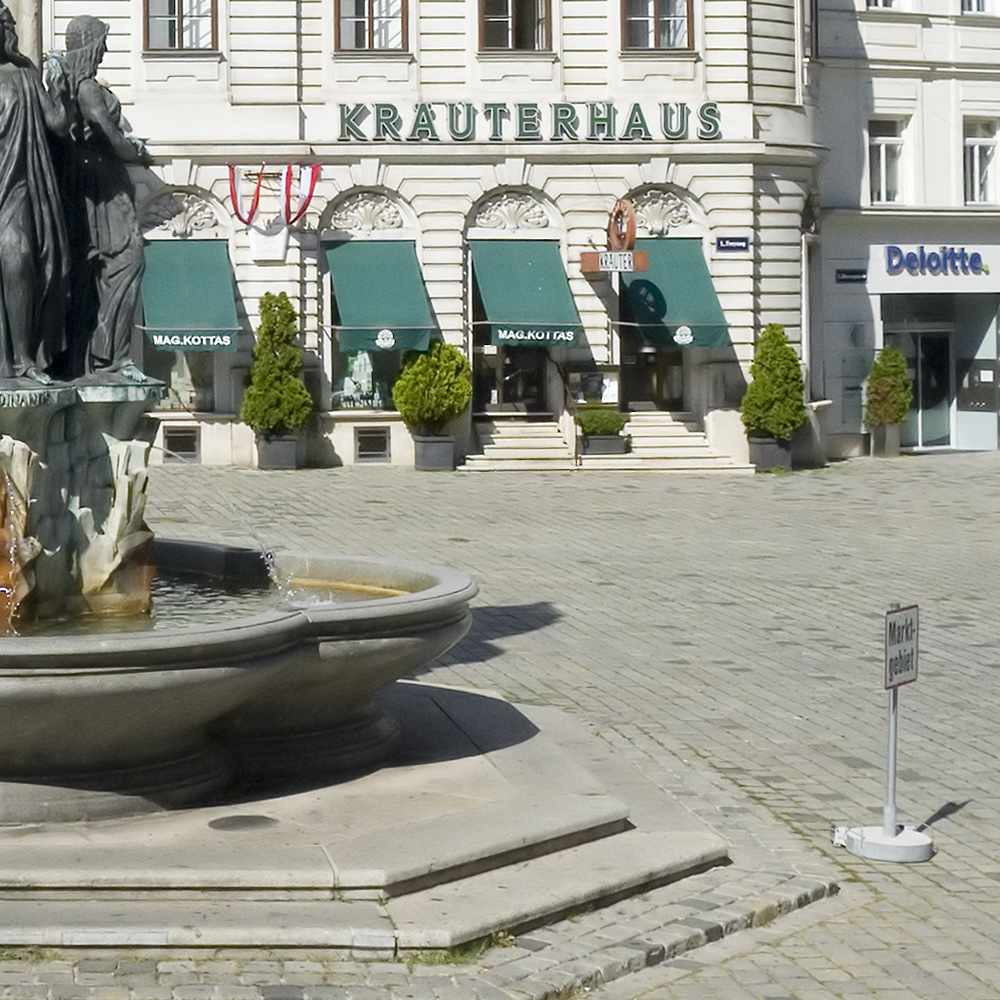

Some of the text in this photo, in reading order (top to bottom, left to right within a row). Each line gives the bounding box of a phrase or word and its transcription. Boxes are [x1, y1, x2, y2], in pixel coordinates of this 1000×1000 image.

[337, 101, 722, 141] KRÄUTERHAUS
[889, 618, 916, 646] Markt-
[889, 648, 914, 681] gebiet
